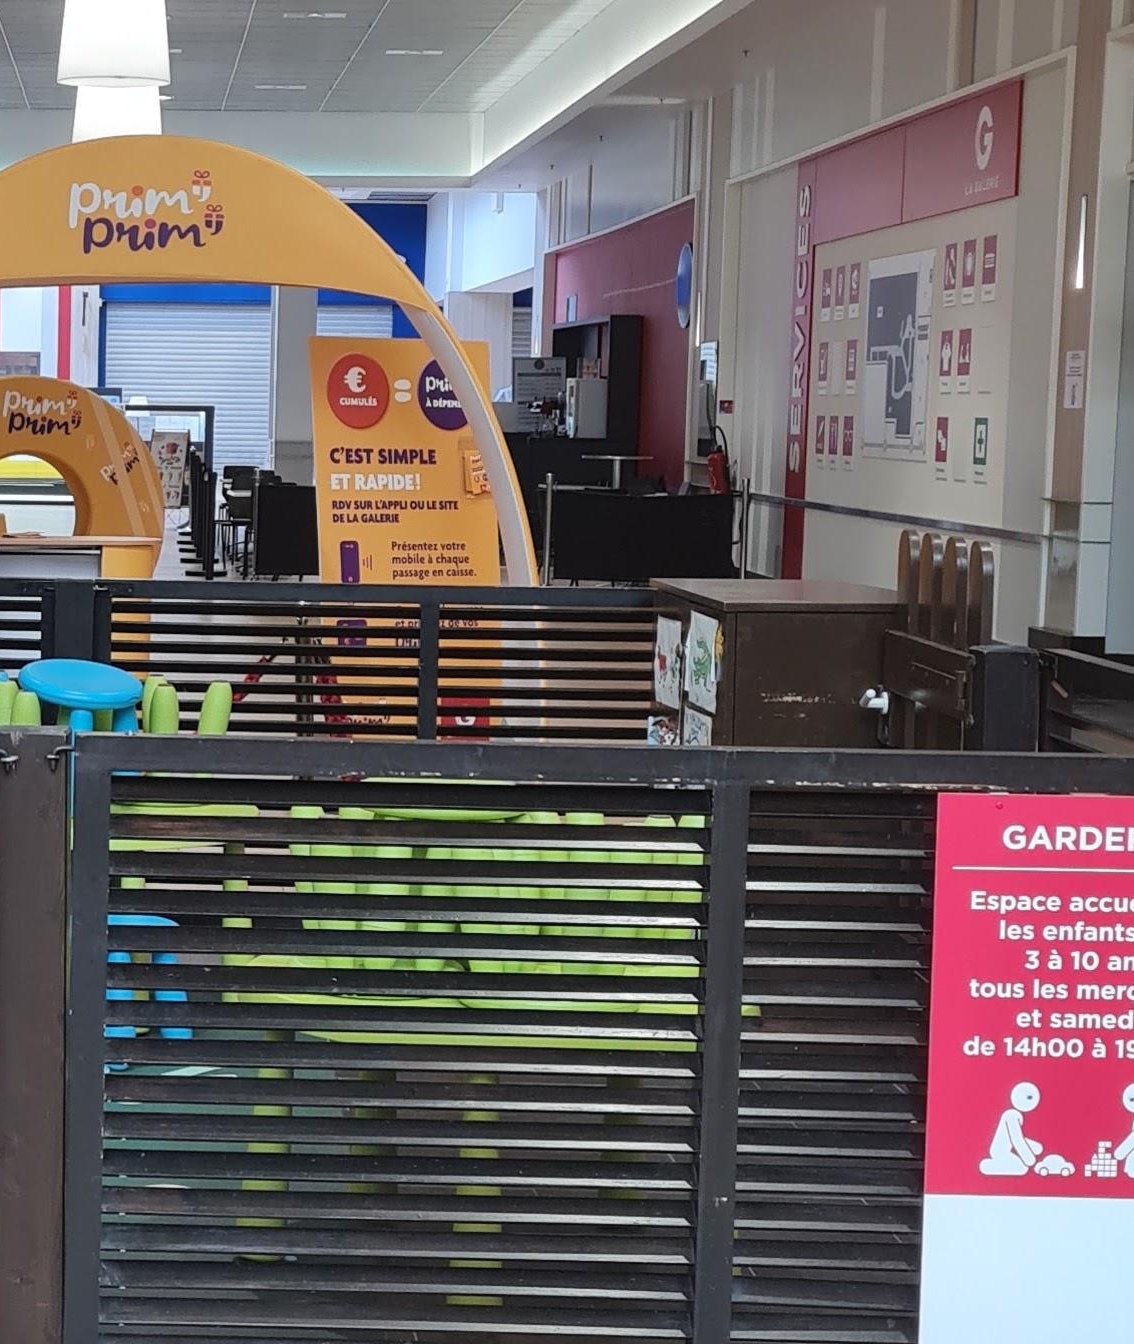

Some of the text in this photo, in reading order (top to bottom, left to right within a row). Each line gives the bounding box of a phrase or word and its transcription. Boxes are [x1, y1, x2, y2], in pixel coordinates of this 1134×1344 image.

[975, 105, 994, 170] G
[787, 184, 812, 473] SERVICES
[339, 396, 378, 407] CUMULÉS
[329, 447, 437, 465] C'EST SIMPLE
[330, 473, 352, 491] ET
[331, 500, 459, 511] RDV SUR L'APPLI OU LE SITE
[332, 513, 400, 523] DE LA GALERIE
[391, 541, 466, 551] Présentez votre
[391, 553, 470, 568] mobile à chaque
[392, 567, 477, 580] passage en caisse.
[970, 890, 1062, 915] Espace
[999, 920, 1035, 940] les
[1024, 950, 1040, 970] 3
[1047, 949, 1062, 970] à
[1070, 951, 1100, 970] 10
[969, 978, 1025, 998] tous
[1033, 978, 1068, 999] les
[1016, 1009, 1042, 1028] et
[963, 1036, 996, 1056] de
[1003, 1037, 1084, 1057] 14h00
[1091, 1038, 1107, 1058] à
